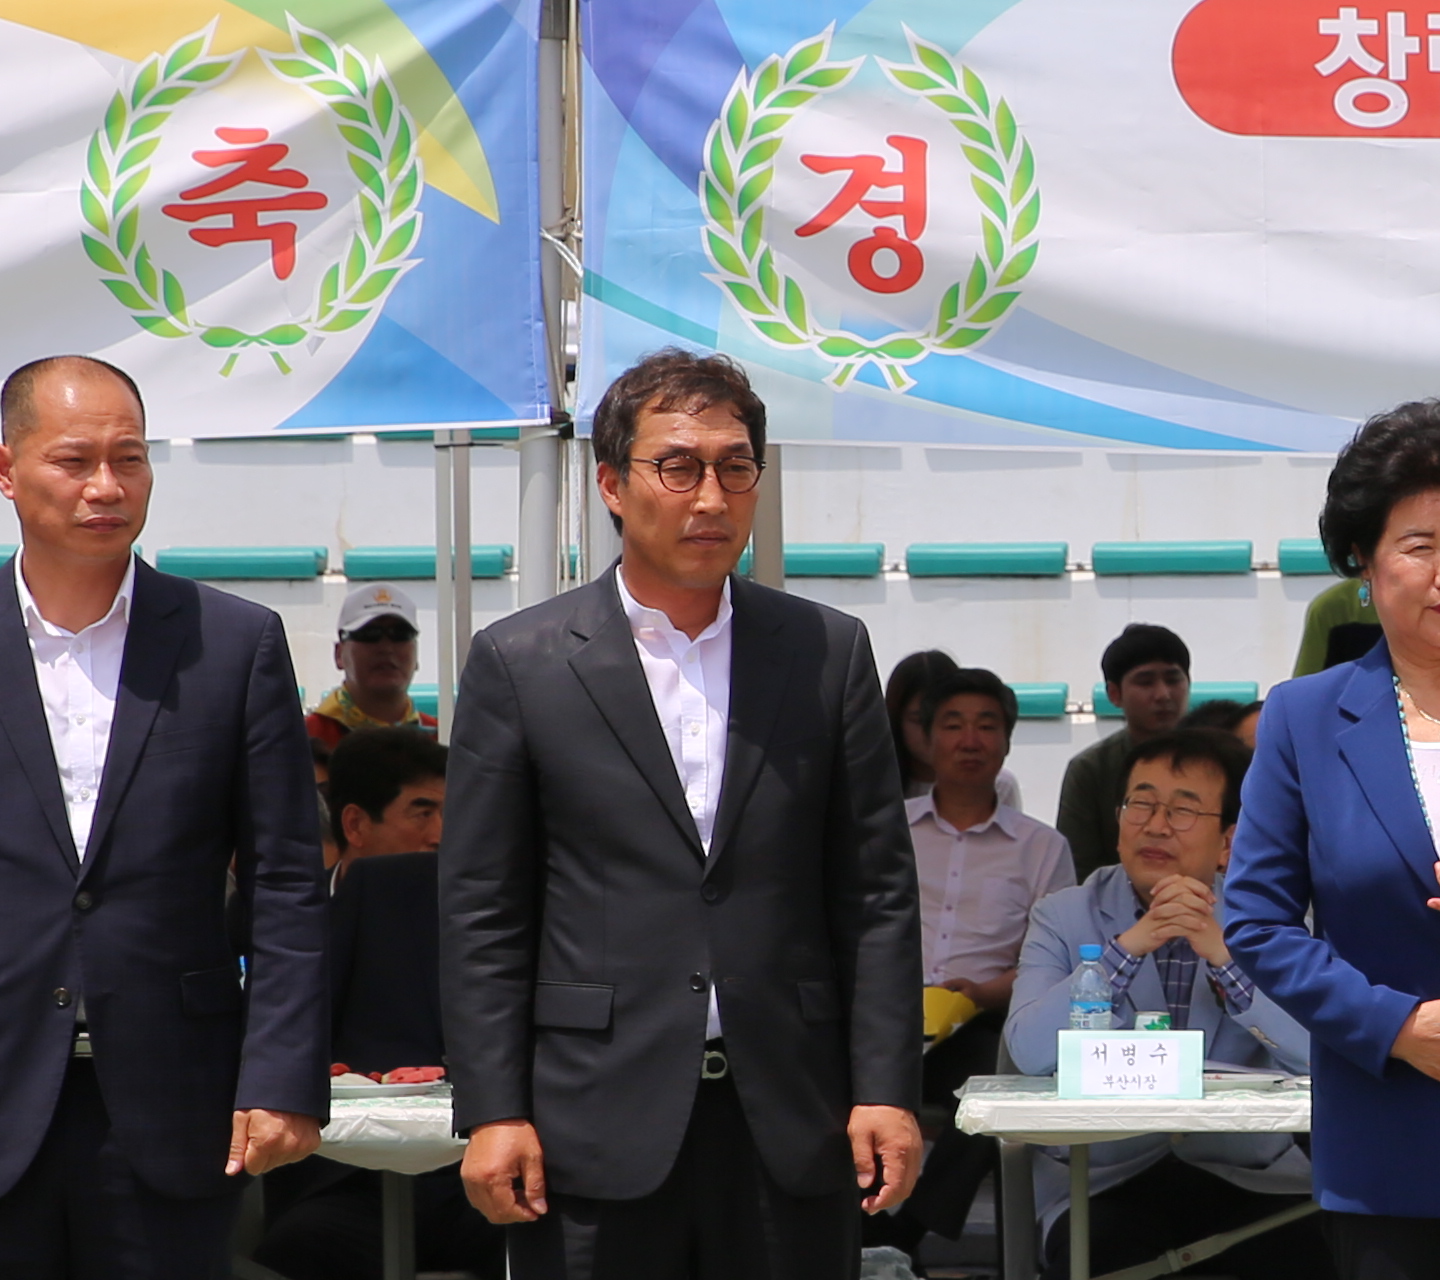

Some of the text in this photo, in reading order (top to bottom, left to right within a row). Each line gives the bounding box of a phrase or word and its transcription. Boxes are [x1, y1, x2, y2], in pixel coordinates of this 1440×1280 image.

[164, 129, 326, 279] 축
[797, 137, 926, 293] 경
[1092, 1042, 1168, 1066] 서 병 수
[1103, 1074, 1157, 1091] 부산시장
